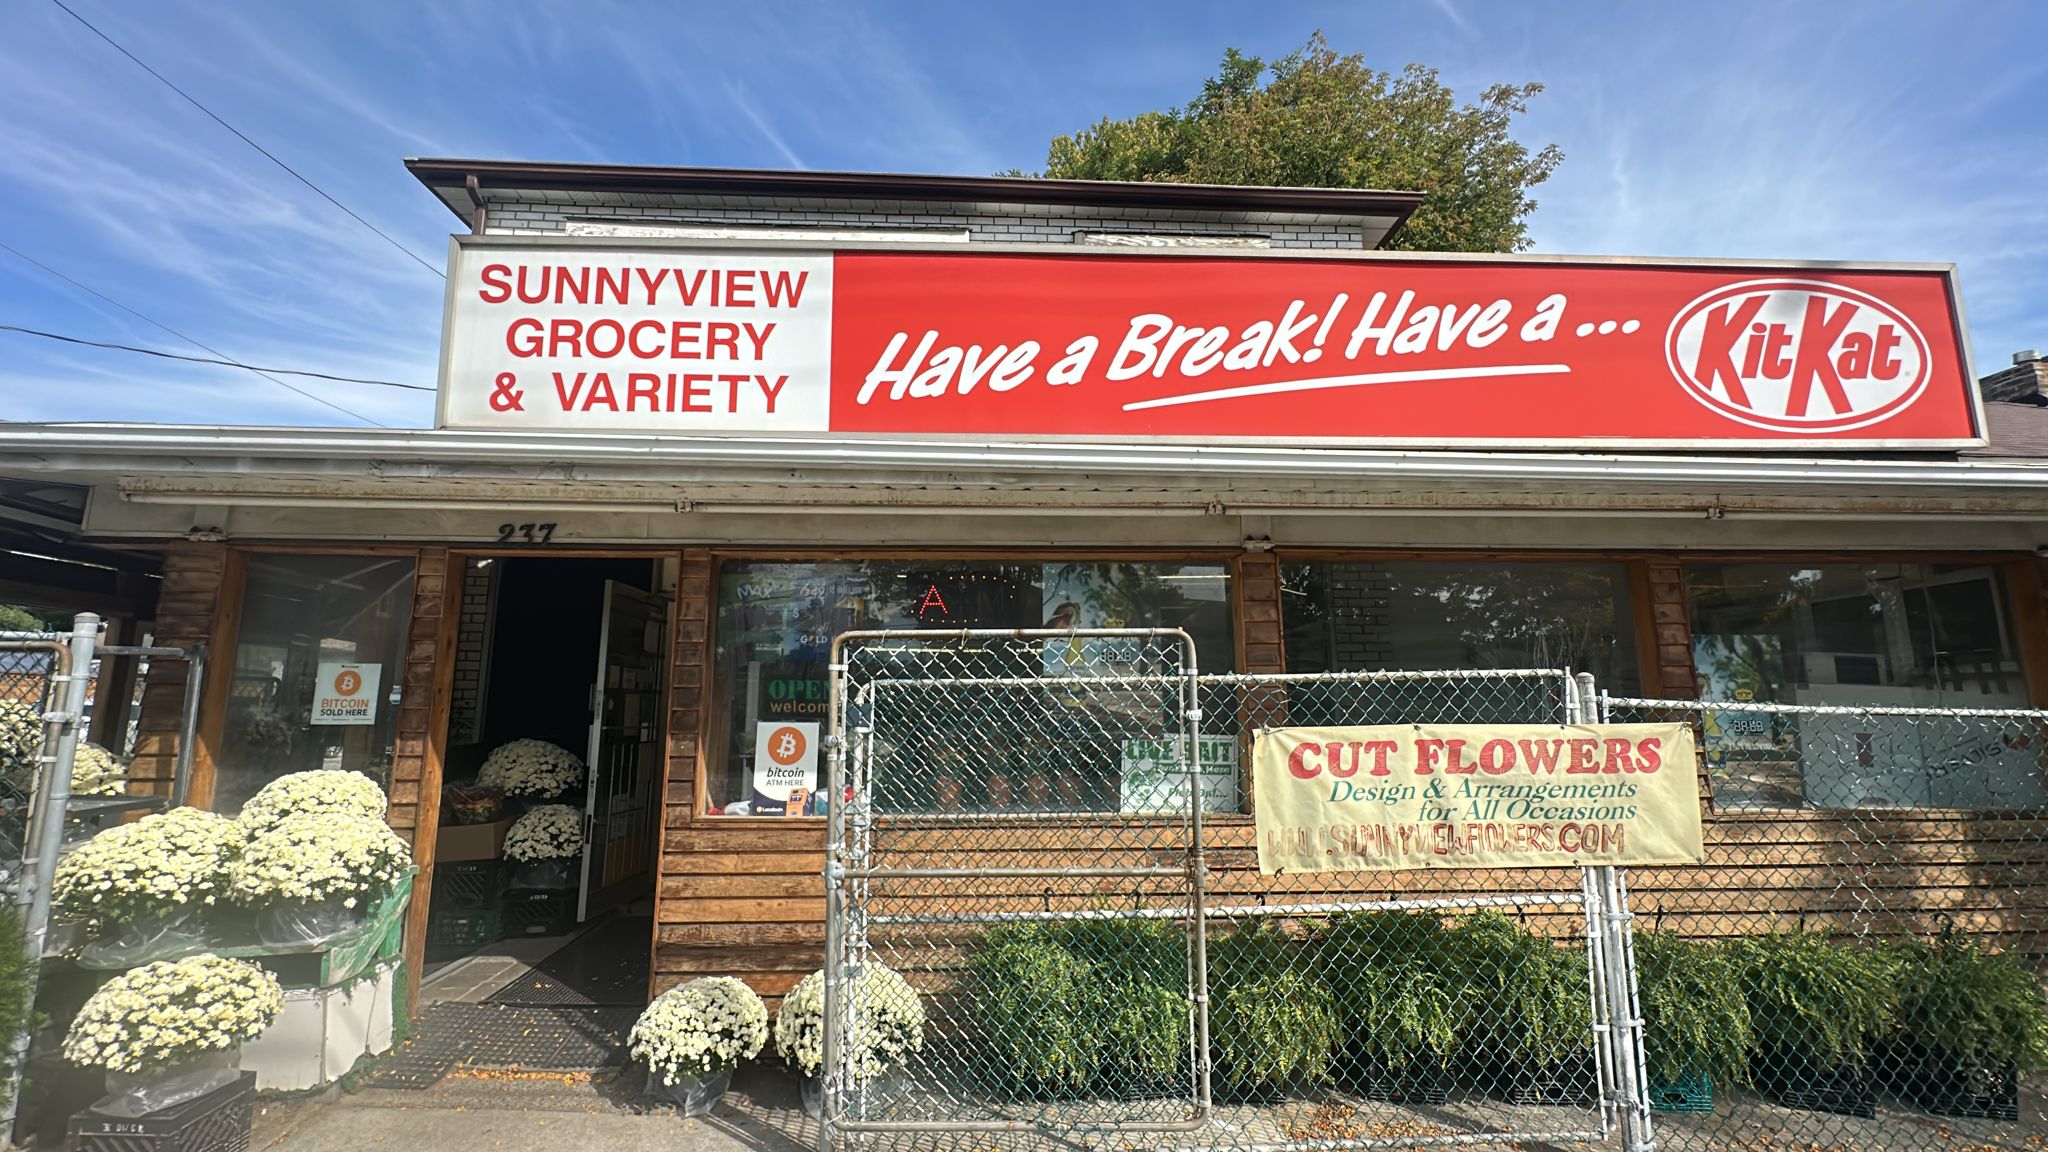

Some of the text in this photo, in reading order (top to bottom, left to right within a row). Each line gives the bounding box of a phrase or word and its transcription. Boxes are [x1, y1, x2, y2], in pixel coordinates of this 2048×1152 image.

[479, 264, 809, 308] SUNNYVIEW
[506, 318, 777, 360] GROCERY
[856, 330, 1041, 405] Have
[1046, 336, 1099, 386] a
[1105, 293, 1349, 381] Break!
[1345, 290, 1512, 360] Have
[1520, 294, 1567, 342] a
[489, 372, 790, 414] & VARIETY
[497, 523, 558, 547] 237
[919, 585, 948, 615] A
[768, 680, 829, 699] OPE
[320, 708, 368, 716] SOLD HERE
[321, 698, 369, 709] BITCOIN
[770, 700, 829, 713] welcom
[1288, 738, 1662, 779] CUT FLOWERS
[766, 766, 805, 778] bitcoin
[766, 779, 805, 787] ATM HERE
[1328, 778, 1638, 806] Design & Arrangements
[1417, 799, 1638, 823] for All Occasions
